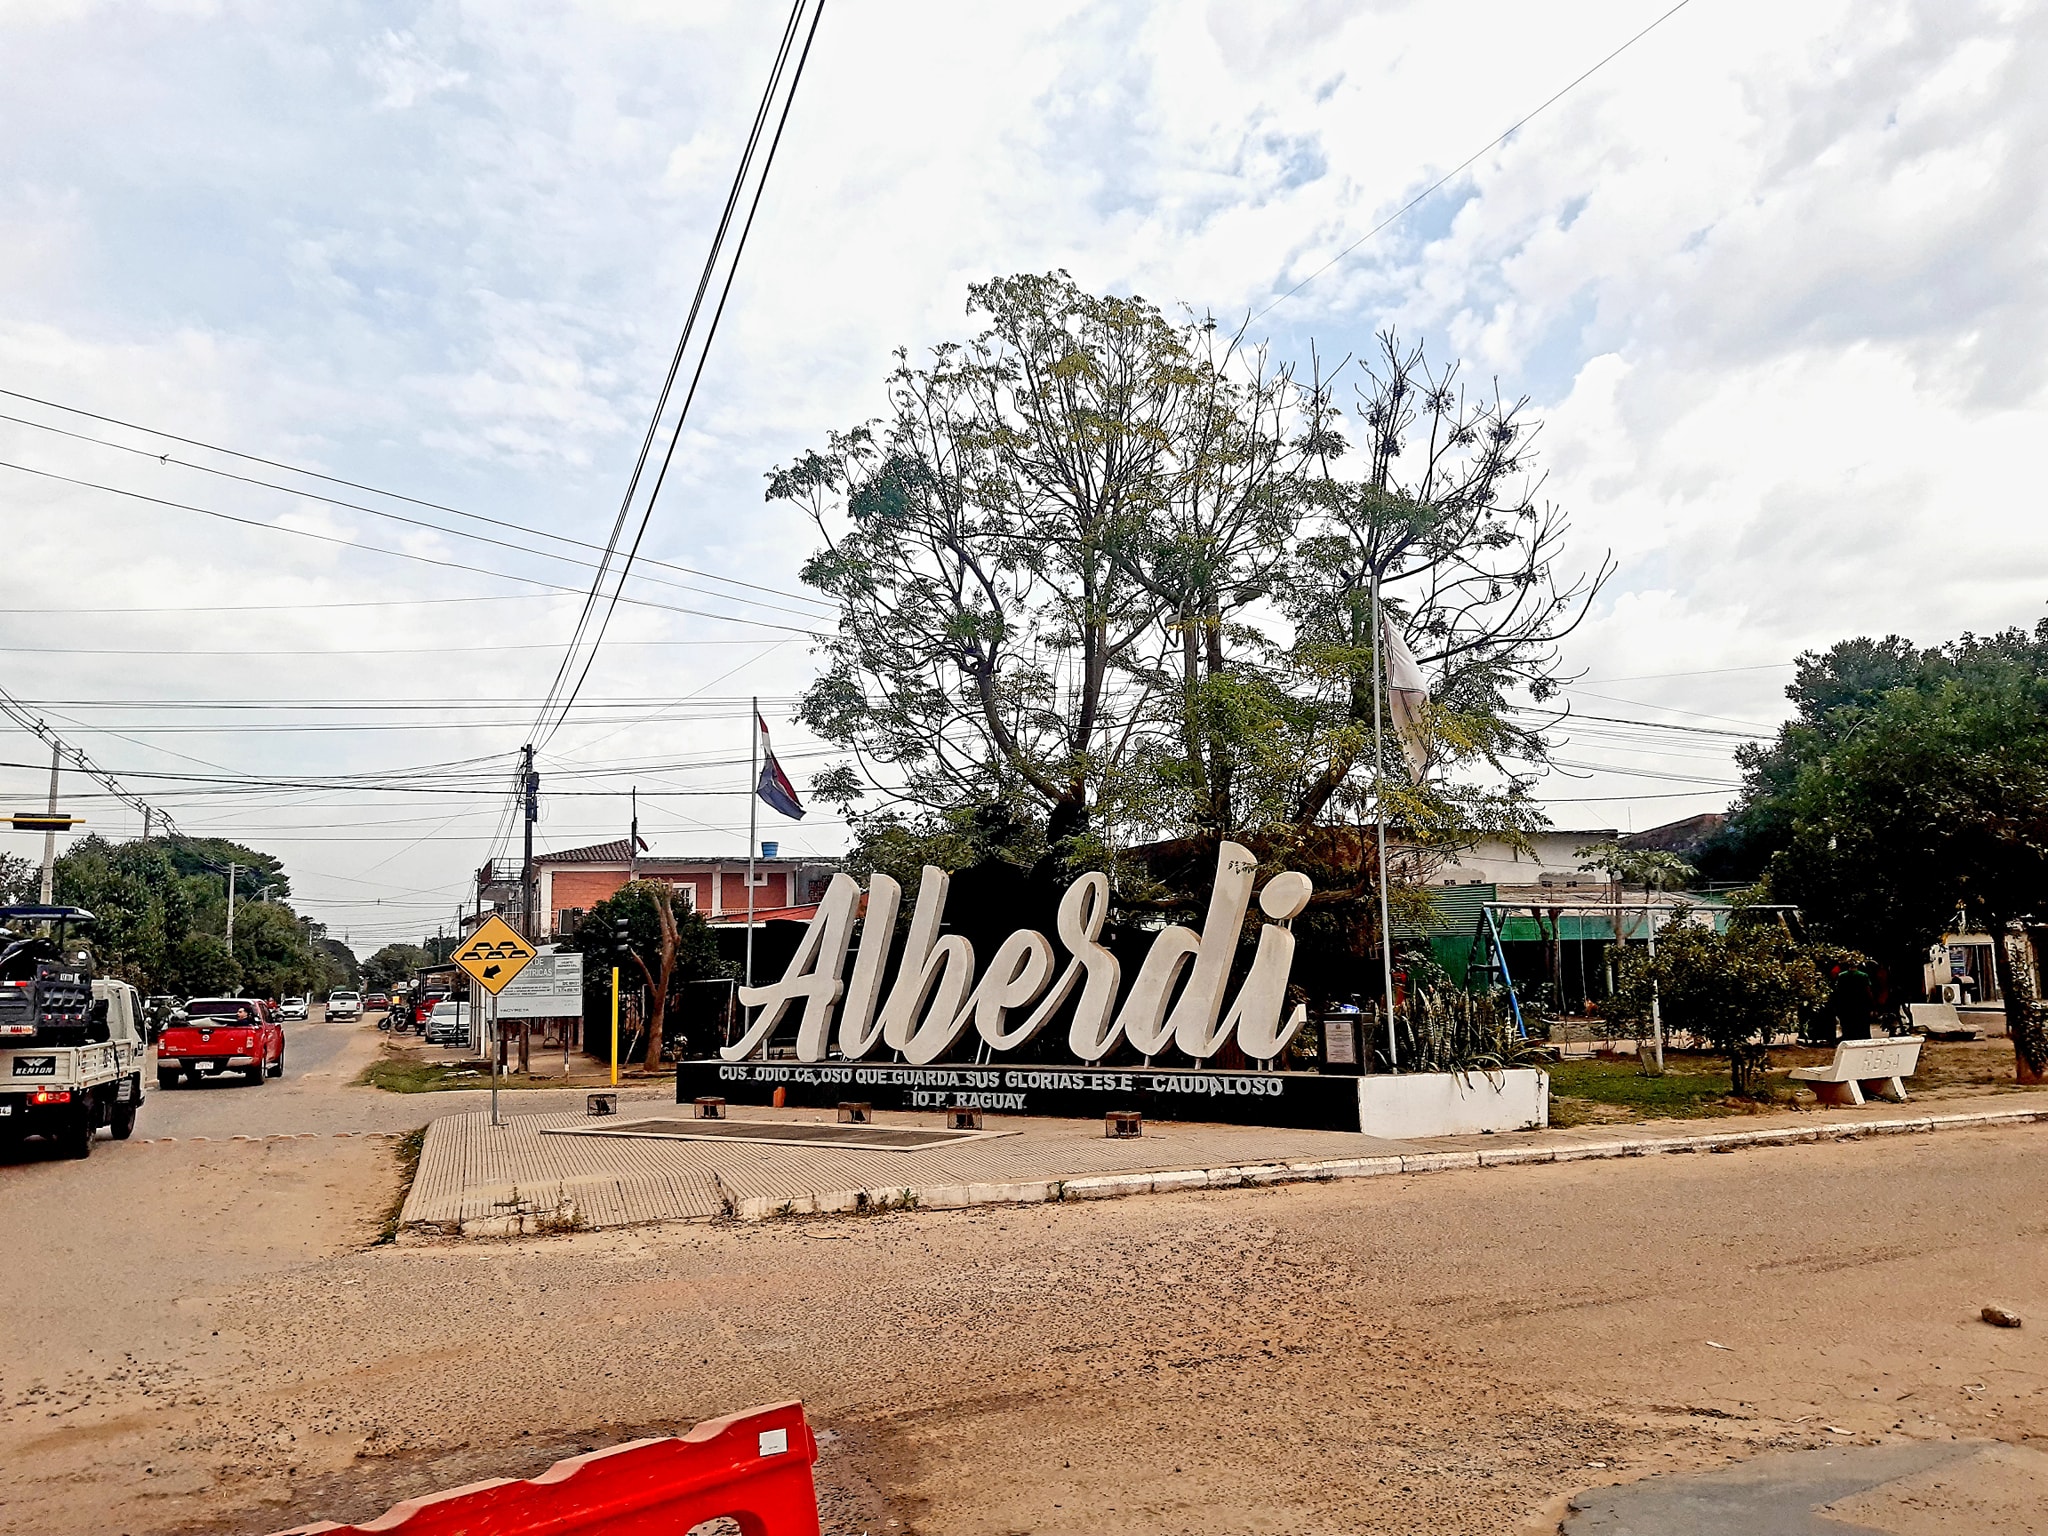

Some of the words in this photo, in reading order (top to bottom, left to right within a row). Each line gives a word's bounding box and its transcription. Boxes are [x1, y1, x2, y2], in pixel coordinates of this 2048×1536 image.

[534, 957, 544, 966] DE
[719, 840, 1313, 1065] Alberdi
[15, 1067, 54, 1075] KENTON
[719, 1065, 790, 1082] CUSODIO
[855, 1068, 888, 1085] QUE
[892, 1069, 960, 1086] GUARDA
[965, 1071, 1000, 1088] SUS
[1005, 1071, 1085, 1090] GLORIAS
[1152, 1074, 1284, 1097] CAUDALOSO
[935, 1091, 1028, 1110] PRAGUAY
